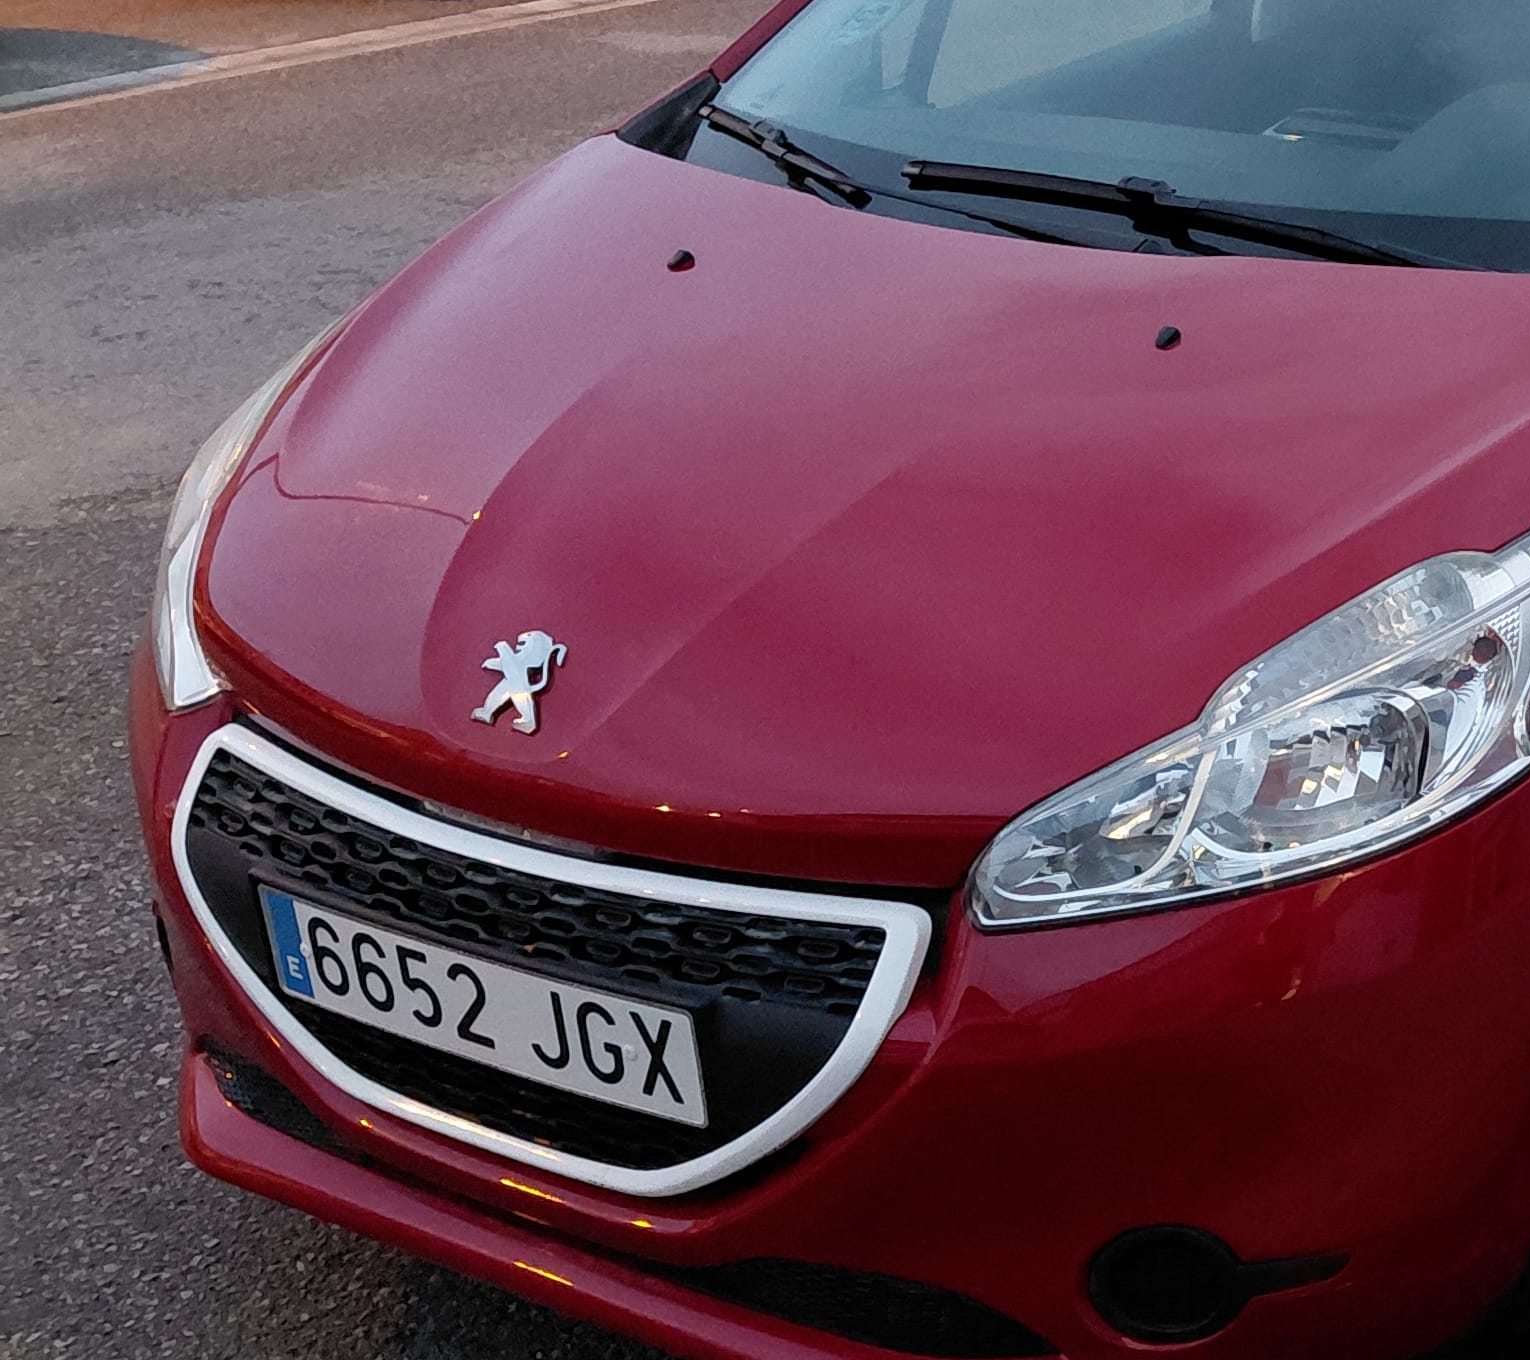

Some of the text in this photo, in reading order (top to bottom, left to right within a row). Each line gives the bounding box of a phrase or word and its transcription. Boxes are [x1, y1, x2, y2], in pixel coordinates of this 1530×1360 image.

[286, 955, 304, 980] E
[307, 916, 685, 1105] 6652 JGX
